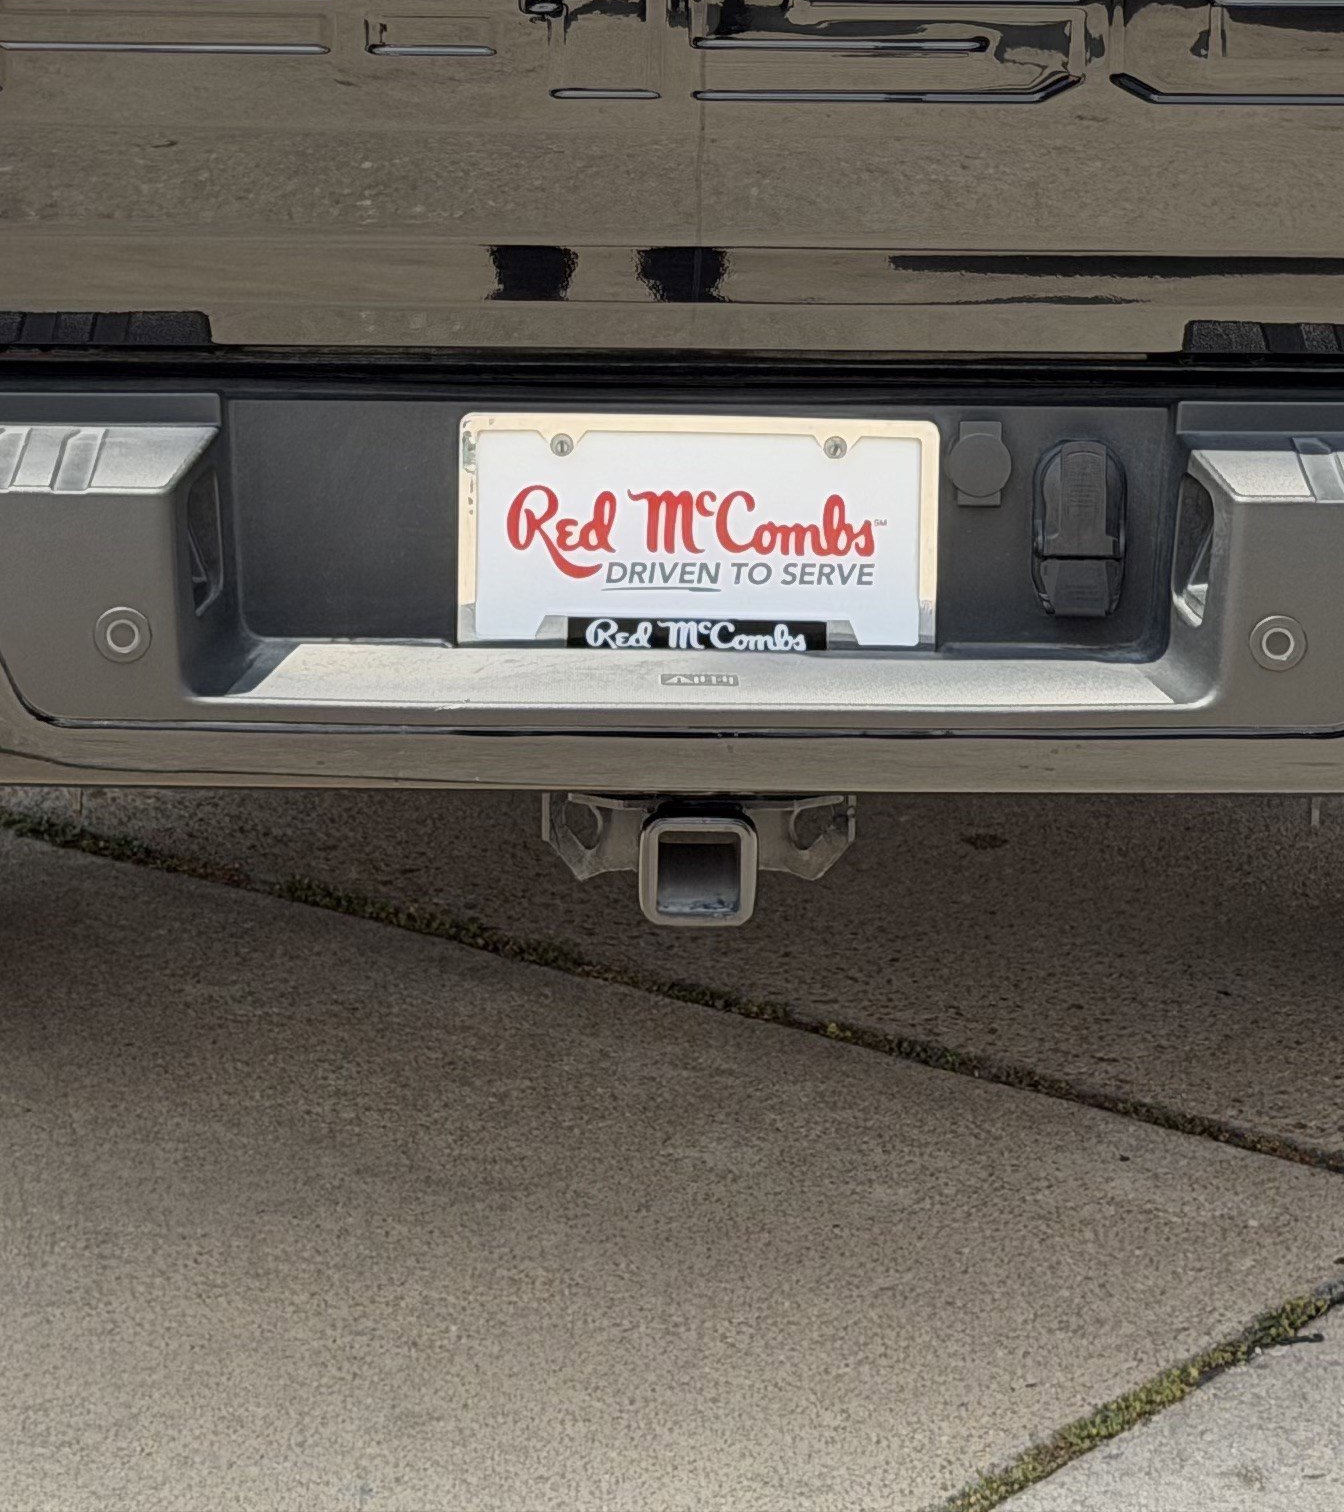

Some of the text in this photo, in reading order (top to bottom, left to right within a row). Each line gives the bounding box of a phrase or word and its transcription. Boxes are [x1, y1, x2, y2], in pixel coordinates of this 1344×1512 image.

[506, 484, 617, 578] Red
[627, 489, 875, 557] McCombs
[605, 561, 876, 586] DRIVEN TO SERVE
[585, 618, 807, 652] Red McCombs
